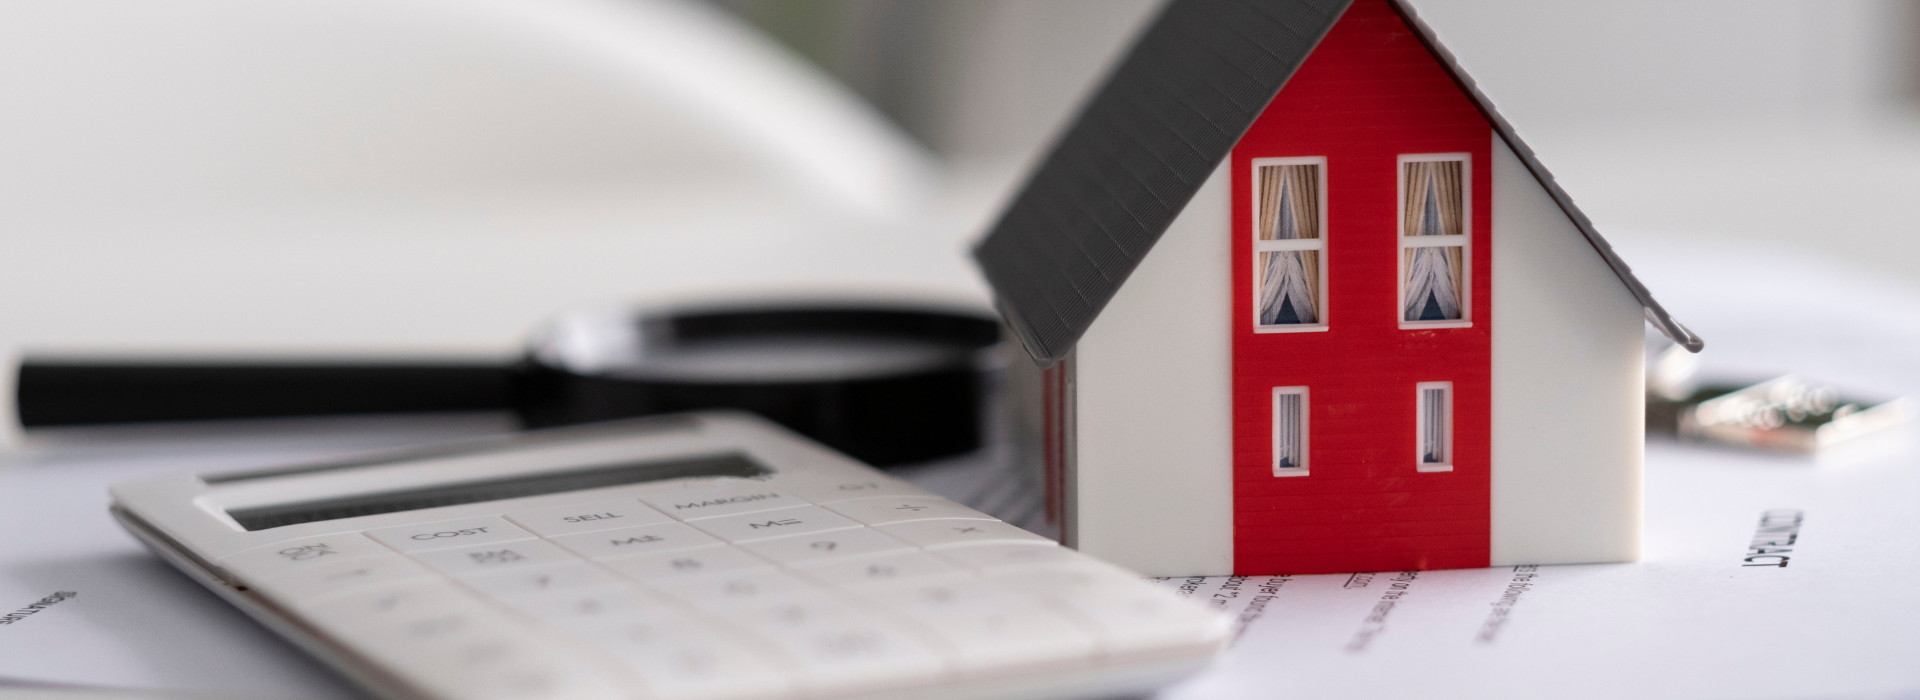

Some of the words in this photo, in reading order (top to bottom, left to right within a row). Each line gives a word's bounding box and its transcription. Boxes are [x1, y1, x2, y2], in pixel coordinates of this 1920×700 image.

[675, 492, 780, 510] MARGIN
[563, 512, 623, 523] SELL
[410, 526, 489, 541] COST
[1511, 573, 1538, 582] the
[1258, 578, 1293, 595] buyer
[1389, 582, 1410, 590] on
[1381, 591, 1409, 600] the
